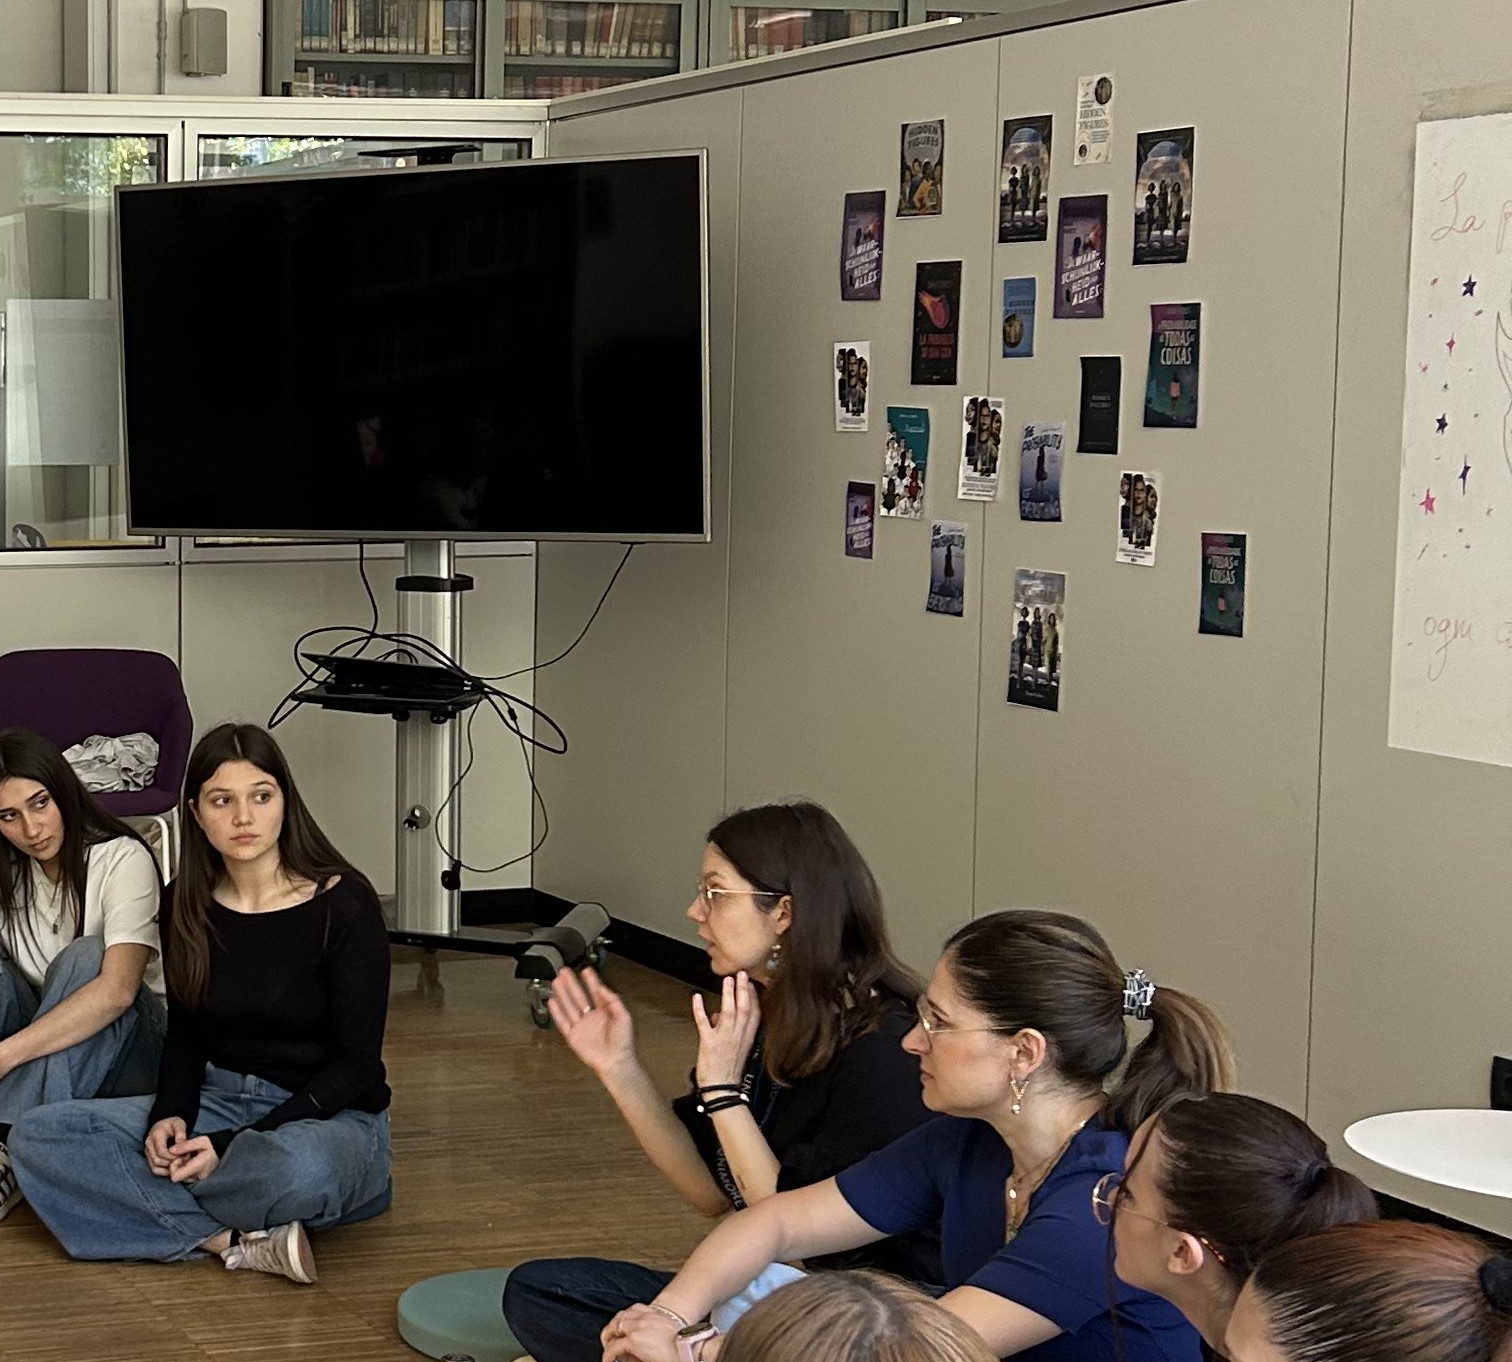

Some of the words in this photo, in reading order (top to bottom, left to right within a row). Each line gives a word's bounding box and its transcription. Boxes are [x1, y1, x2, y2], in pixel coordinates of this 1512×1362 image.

[908, 124, 939, 138] HIDDEN
[907, 135, 939, 149] FIGURES
[1430, 172, 1487, 241] La
[854, 270, 878, 290] ALLES
[1071, 283, 1100, 307] ALLES
[1163, 330, 1191, 347] TODAS
[1160, 347, 1192, 365] COISAS
